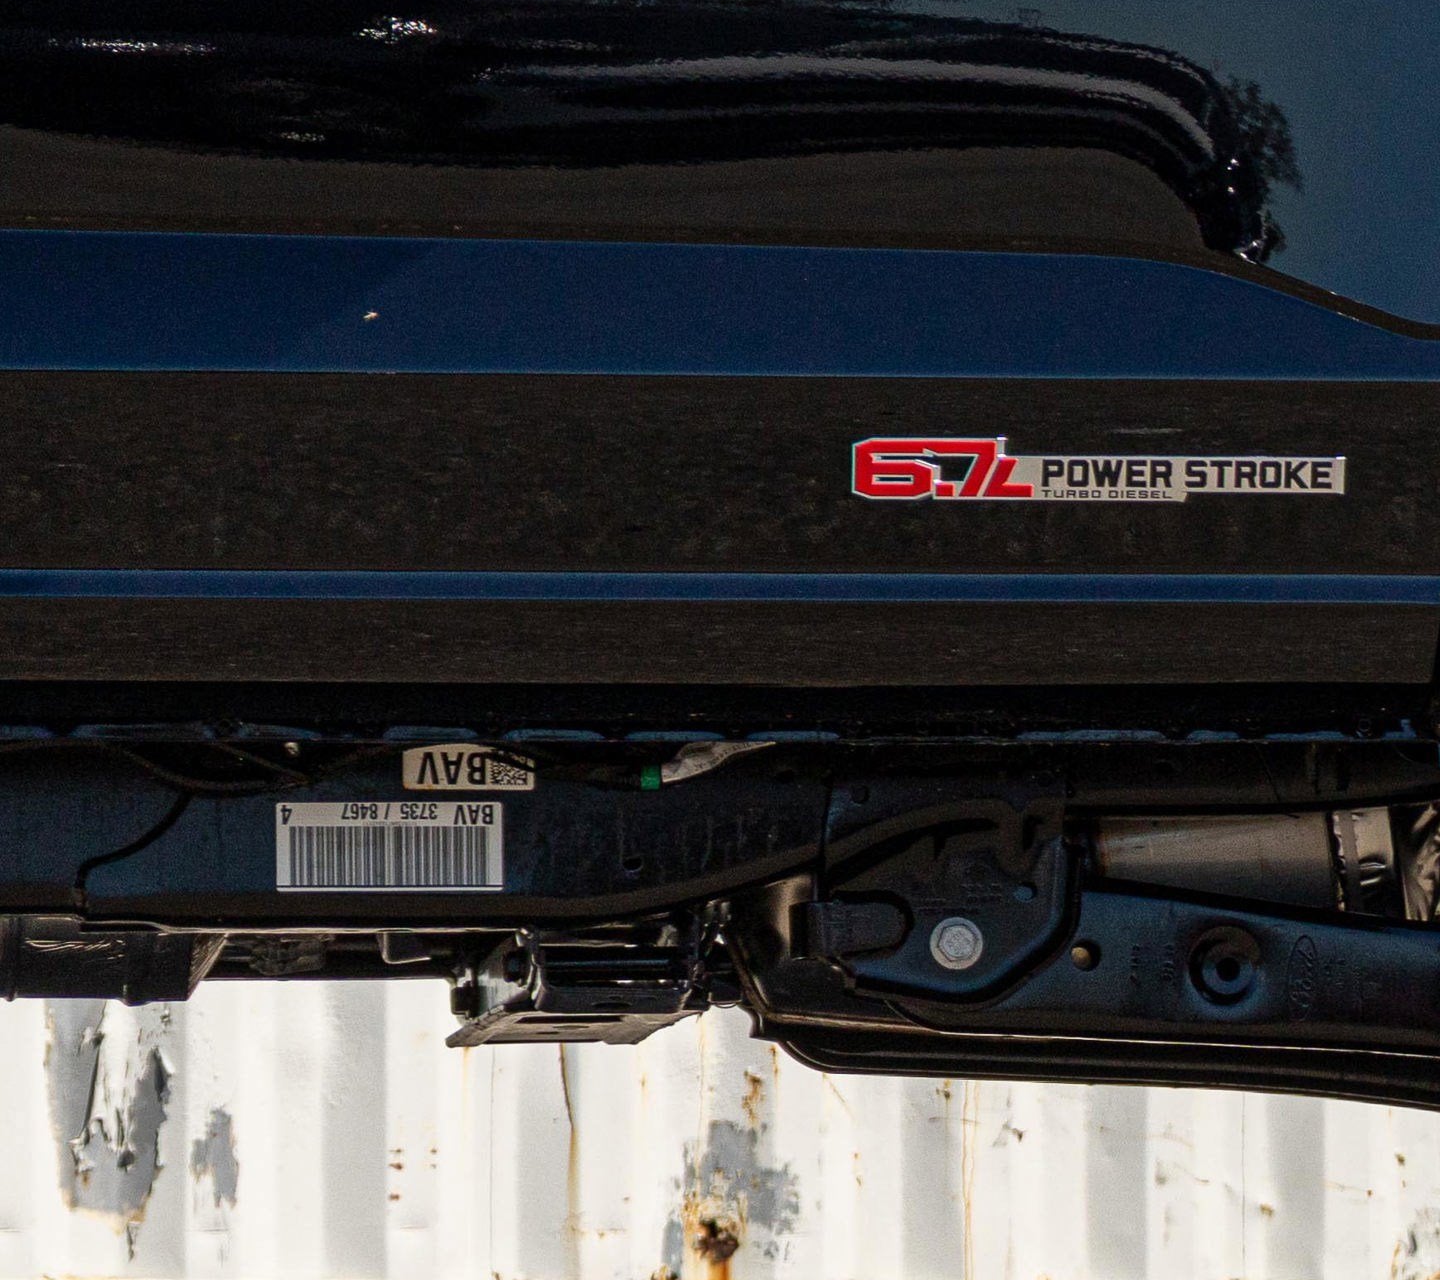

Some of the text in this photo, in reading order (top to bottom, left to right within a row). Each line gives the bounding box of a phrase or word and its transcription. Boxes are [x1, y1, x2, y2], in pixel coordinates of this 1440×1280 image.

[852, 437, 1334, 500] 6.7L POWER STROKE
[1041, 490, 1173, 500] TURBO DIESEL
[416, 751, 487, 785] BAV
[281, 804, 293, 825] 4
[341, 802, 378, 820] 8467
[400, 803, 438, 820] 3735
[453, 803, 494, 825] BAV
